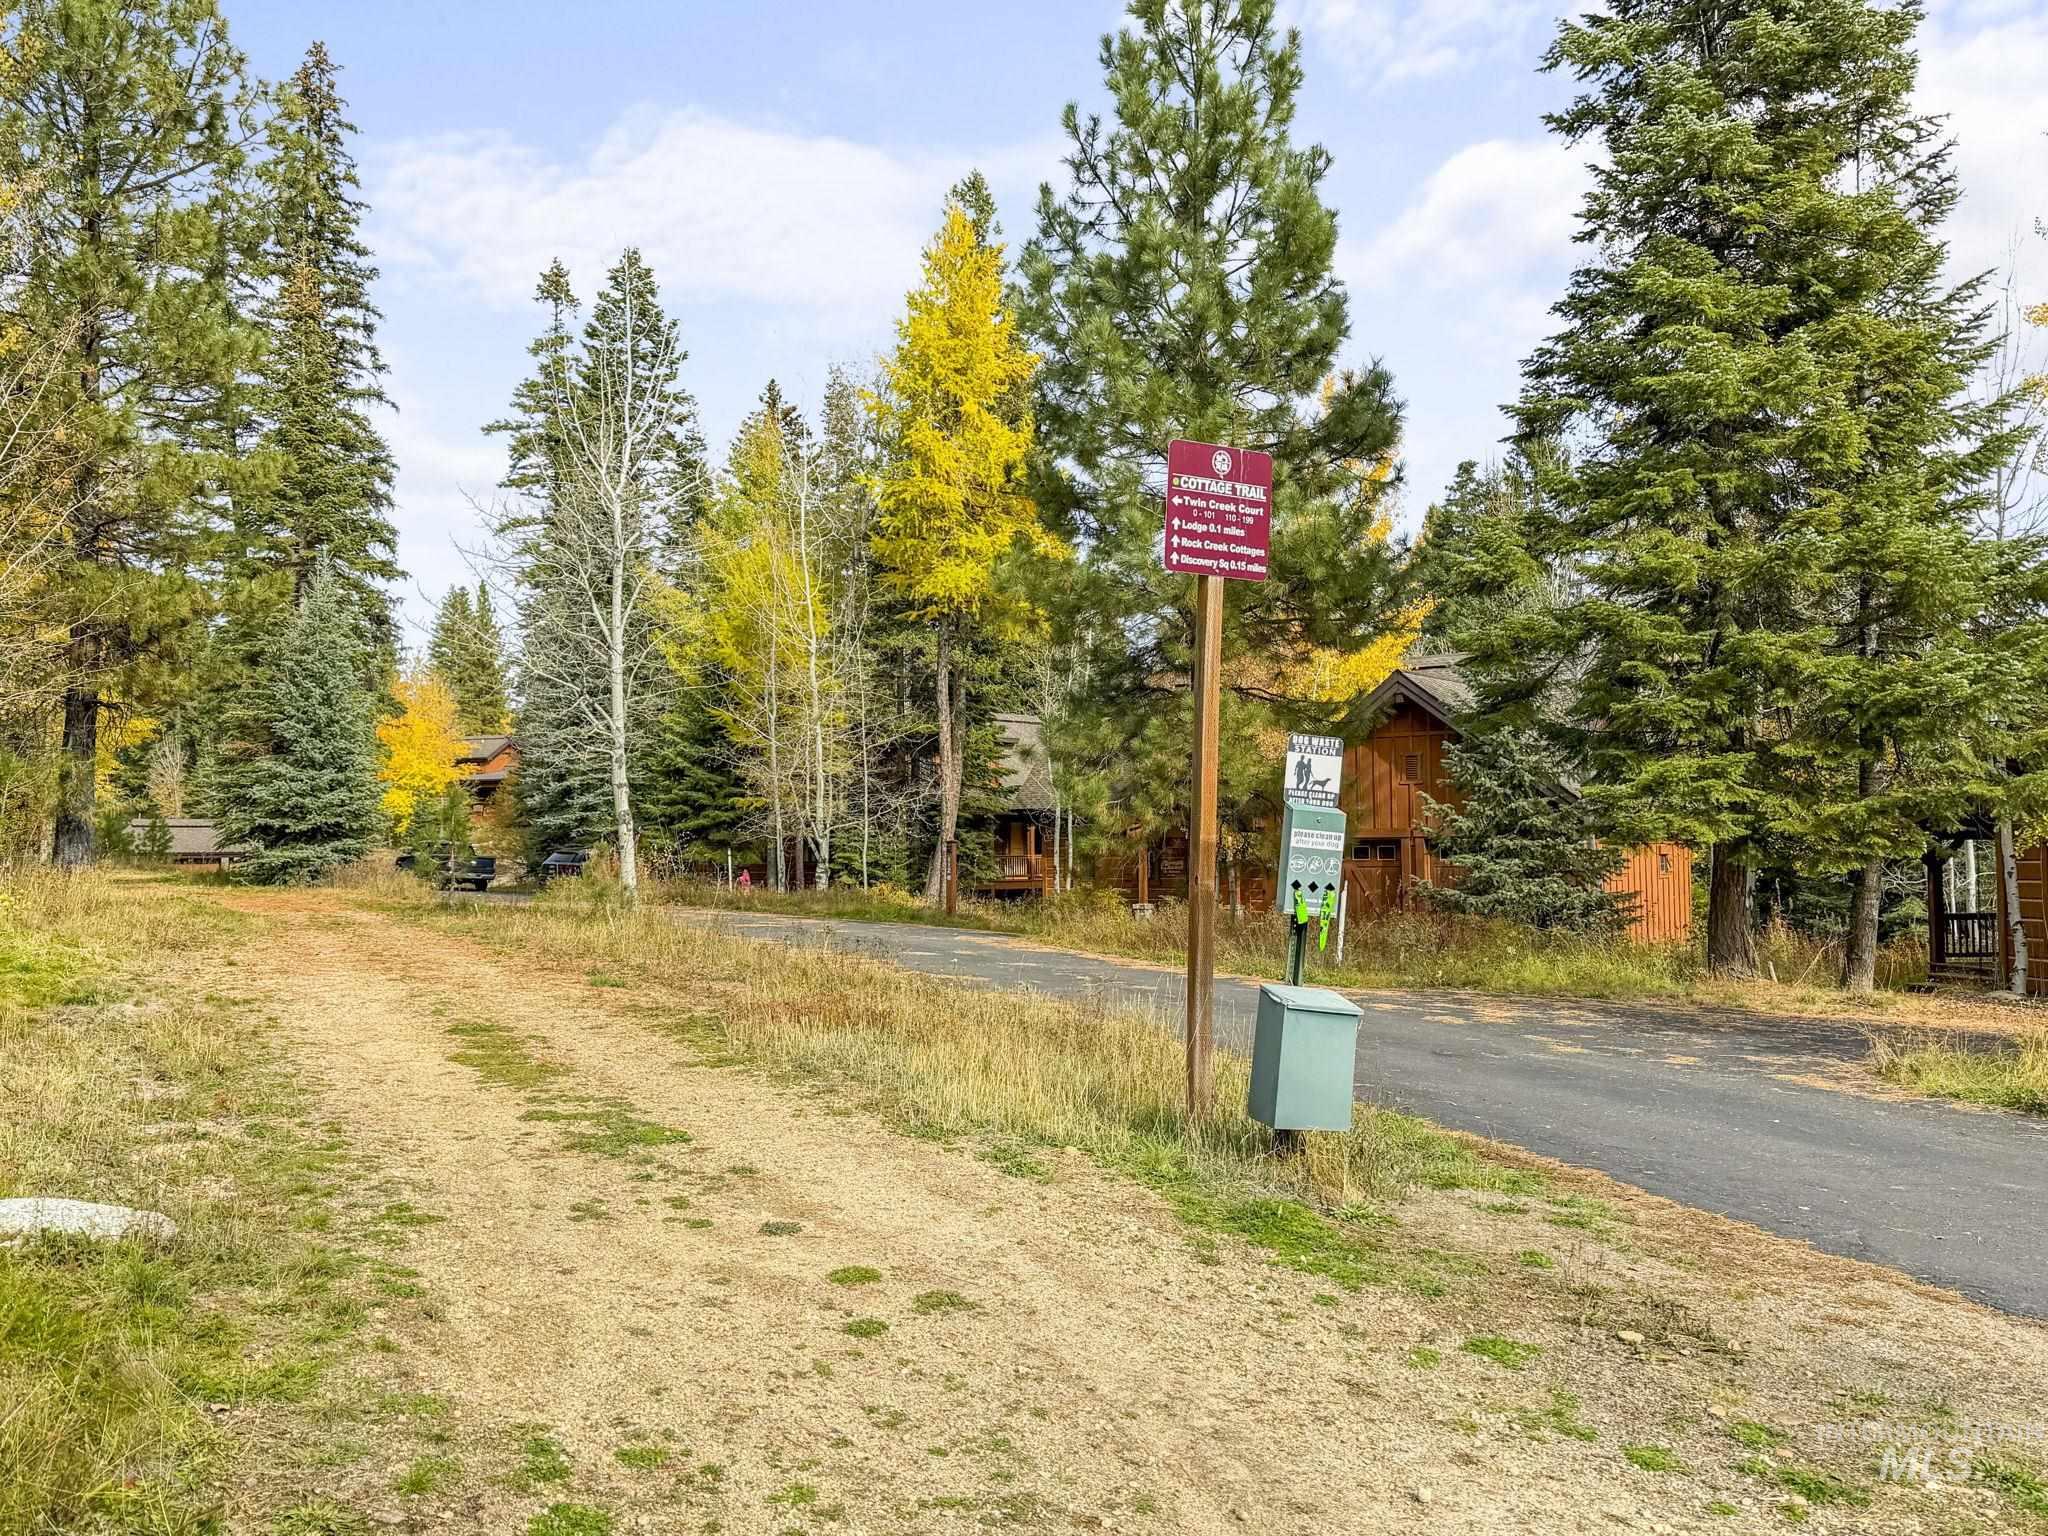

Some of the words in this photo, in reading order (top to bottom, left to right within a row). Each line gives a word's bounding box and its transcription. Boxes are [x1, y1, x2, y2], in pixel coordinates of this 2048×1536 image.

[1180, 476, 1233, 495] COTTAGE
[1235, 484, 1267, 500] TRAIL
[1183, 496, 1207, 508] Twin
[1208, 499, 1237, 512] Creek
[1238, 503, 1264, 516] Court
[1182, 519, 1207, 532] Lodge
[1208, 524, 1221, 534] 0.1
[1223, 525, 1245, 537] miles
[1180, 537, 1202, 548] Rock
[1203, 540, 1228, 552] Creek
[1229, 543, 1265, 558] Cottages
[1180, 554, 1218, 569] Discovery
[1218, 558, 1230, 571] Sq
[1230, 560, 1247, 571] 0.15
[1247, 562, 1267, 573] miles
[1295, 745, 1336, 756] STATION
[1311, 736, 1340, 748] WASTE
[1293, 830, 1315, 838] please
[1315, 832, 1333, 840] clean
